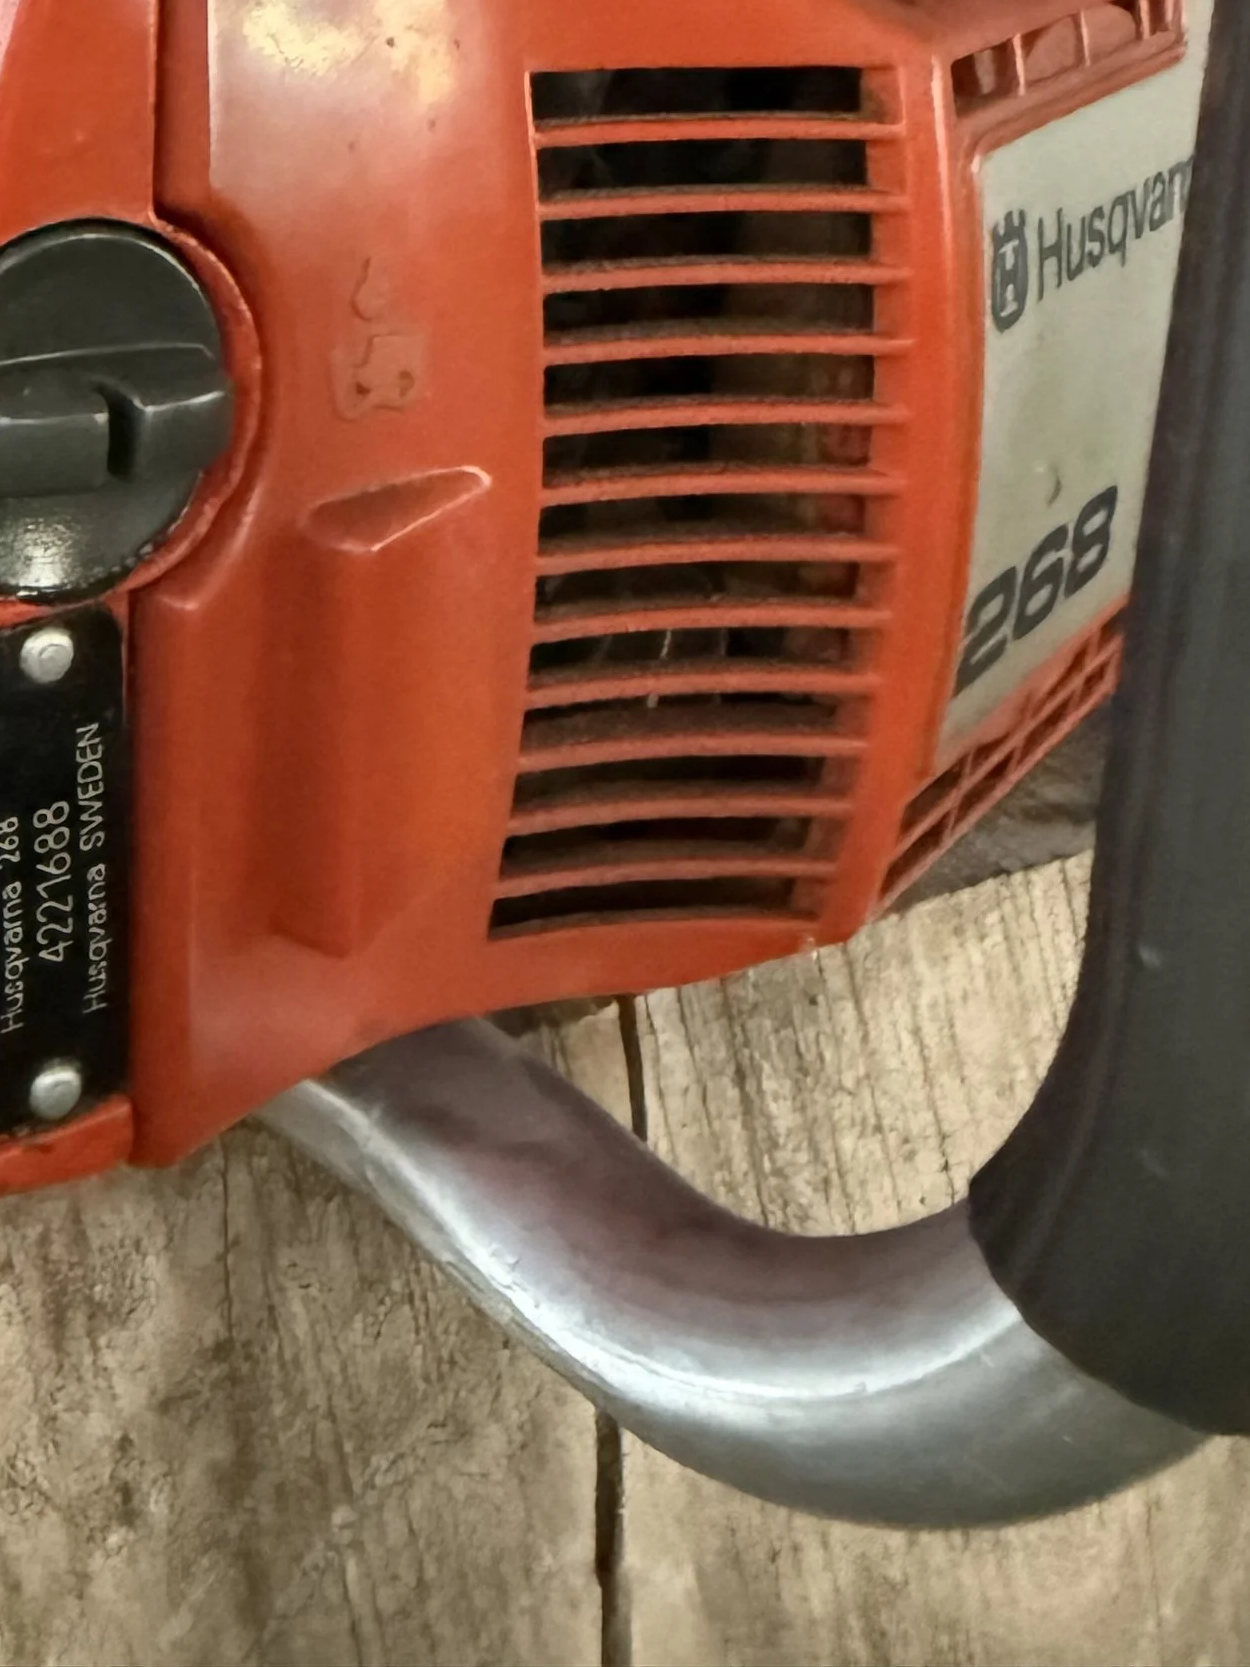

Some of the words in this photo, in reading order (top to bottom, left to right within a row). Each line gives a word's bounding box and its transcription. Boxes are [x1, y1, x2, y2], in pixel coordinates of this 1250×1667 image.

[951, 484, 1118, 698] 268
[75, 722, 105, 852] SWEDEN
[0, 881, 30, 1034] Husqvarna
[32, 800, 74, 962] 4221688
[82, 863, 112, 1014] Husqvarna
